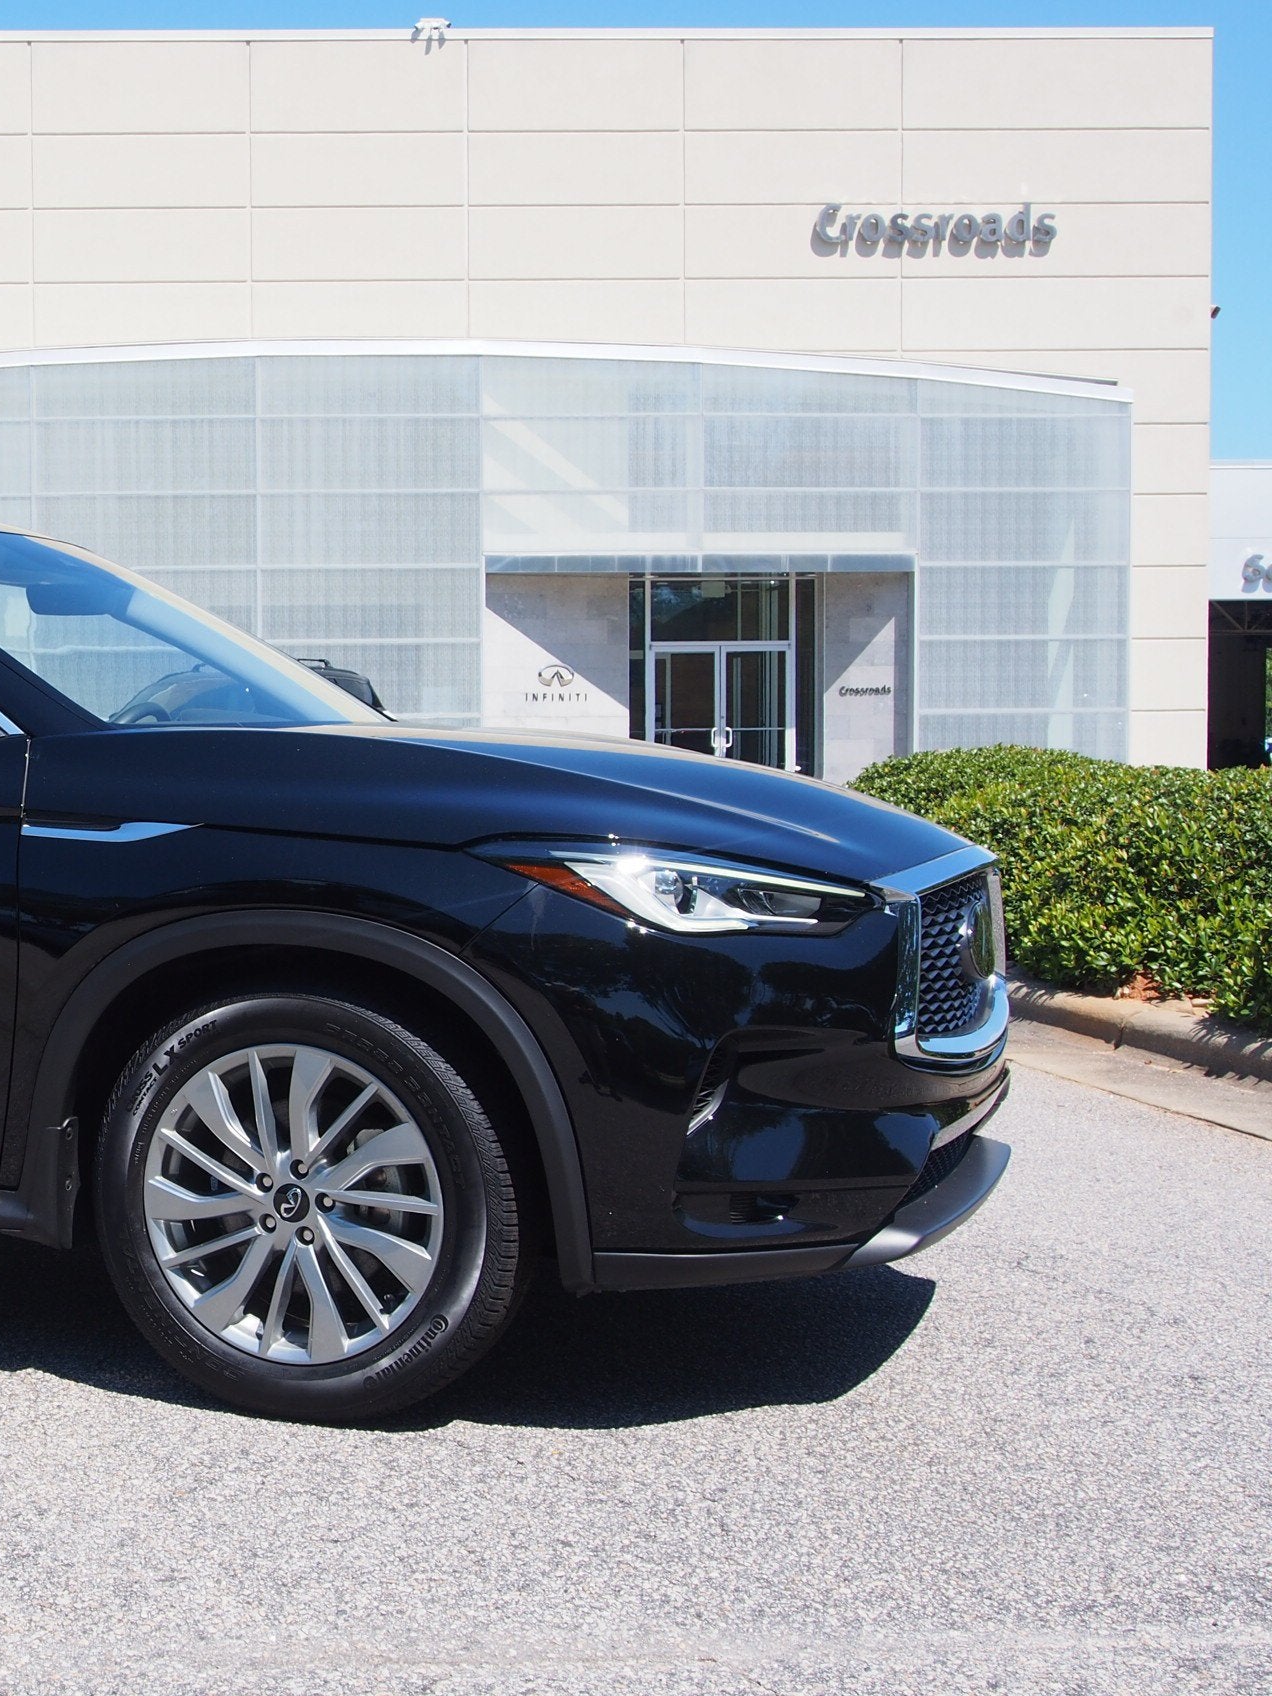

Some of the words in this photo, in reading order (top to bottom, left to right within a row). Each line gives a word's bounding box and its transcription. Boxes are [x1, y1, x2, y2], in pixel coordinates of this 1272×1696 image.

[816, 201, 1058, 243] Crossroads
[525, 692, 588, 702] INFINITI
[839, 685, 892, 697] Crossroads
[177, 1019, 218, 1049] SPORT
